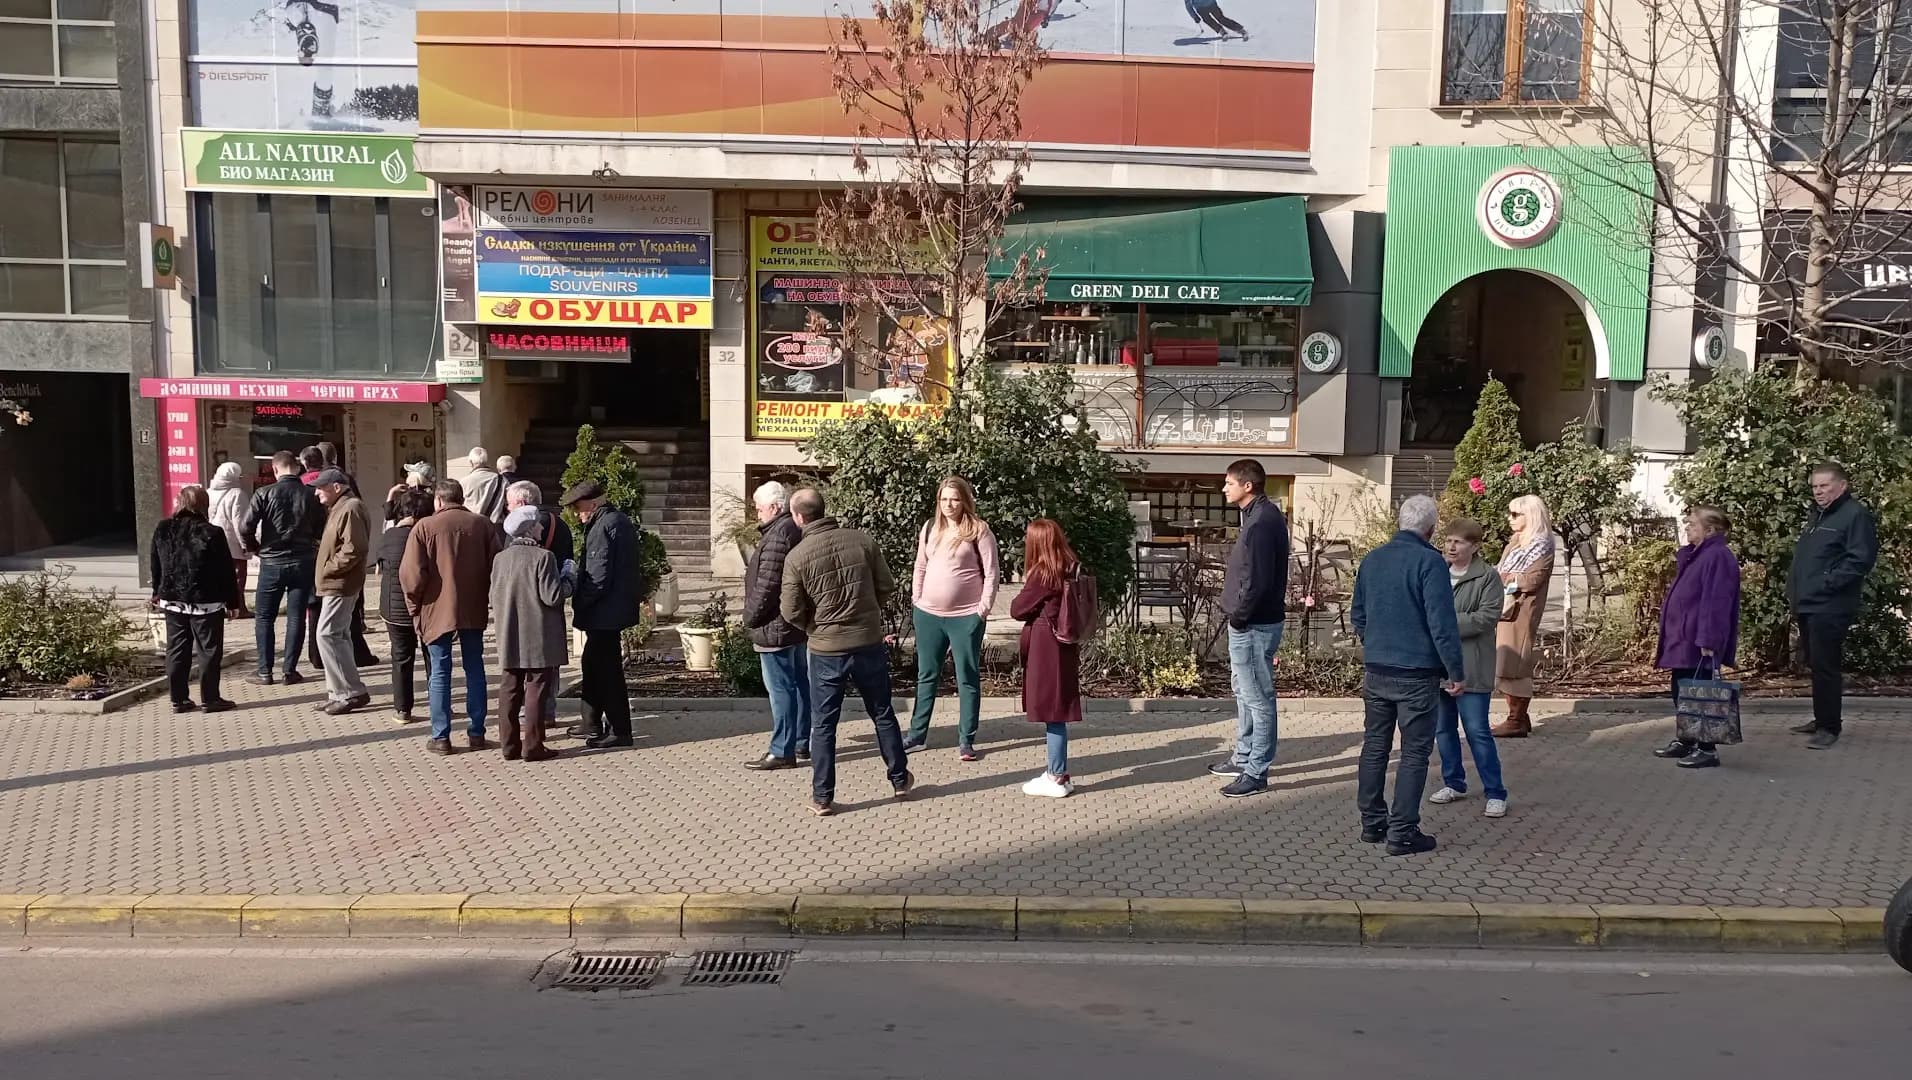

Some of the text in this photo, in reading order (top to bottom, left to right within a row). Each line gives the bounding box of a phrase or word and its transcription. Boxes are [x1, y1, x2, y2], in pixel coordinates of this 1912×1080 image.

[209, 72, 269, 81] DIELSPORT
[219, 142, 375, 165] ALL NATURAL
[219, 166, 335, 182] БИО МАГАЗИН
[600, 192, 667, 202] ЗАНИМАЛНЯ
[533, 214, 594, 226] центрове
[652, 216, 701, 226] ЛОЗЕНЕЦ
[618, 242, 636, 252] от
[639, 239, 698, 256] Украйна
[770, 247, 813, 256] РЕМОНТ
[760, 257, 798, 267] ЧАНТИ,
[519, 264, 605, 280] ПОДАРЪЦИ
[617, 266, 669, 280] ЧАНТИ
[550, 280, 638, 292] SOUVENIRS
[773, 278, 840, 289] МАШИННО
[786, 291, 805, 301] НА
[1071, 284, 1220, 300] GREEN DELI CAFE
[529, 299, 698, 325] ОБУЩАР
[451, 333, 474, 352] 32
[490, 333, 627, 353] ЧАСОВНИЦИ
[777, 342, 800, 353] 200
[719, 351, 735, 362] 32
[783, 354, 828, 365] услуги
[756, 402, 831, 417] РЕМОНТ
[841, 404, 864, 417] НА
